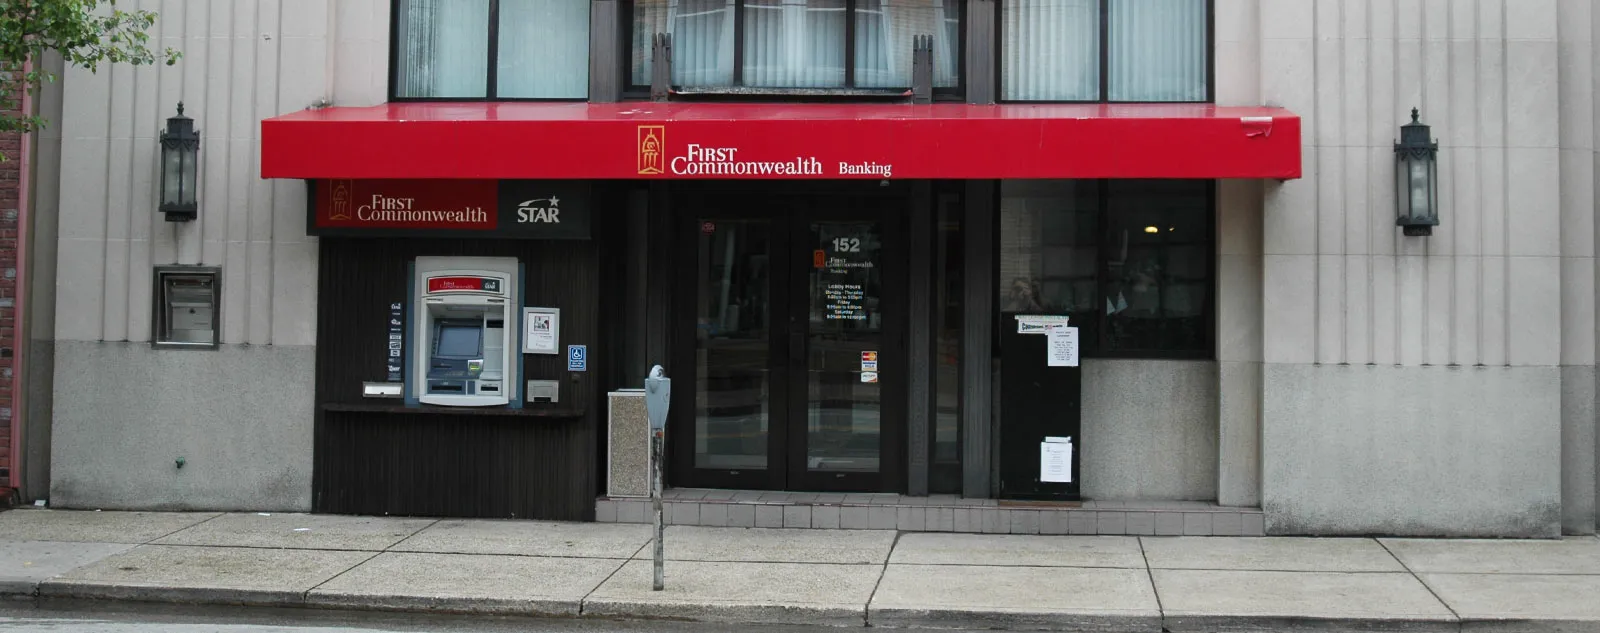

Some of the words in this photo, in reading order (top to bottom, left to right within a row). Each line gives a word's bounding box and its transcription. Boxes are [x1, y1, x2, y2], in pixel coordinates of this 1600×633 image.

[687, 143, 737, 162] FIRST
[671, 157, 823, 175] Commonwealth
[839, 161, 892, 177] Banking
[371, 194, 415, 210] FIRST
[357, 204, 487, 223] Commonwealth
[517, 207, 560, 223] STAR
[832, 237, 860, 252] 152
